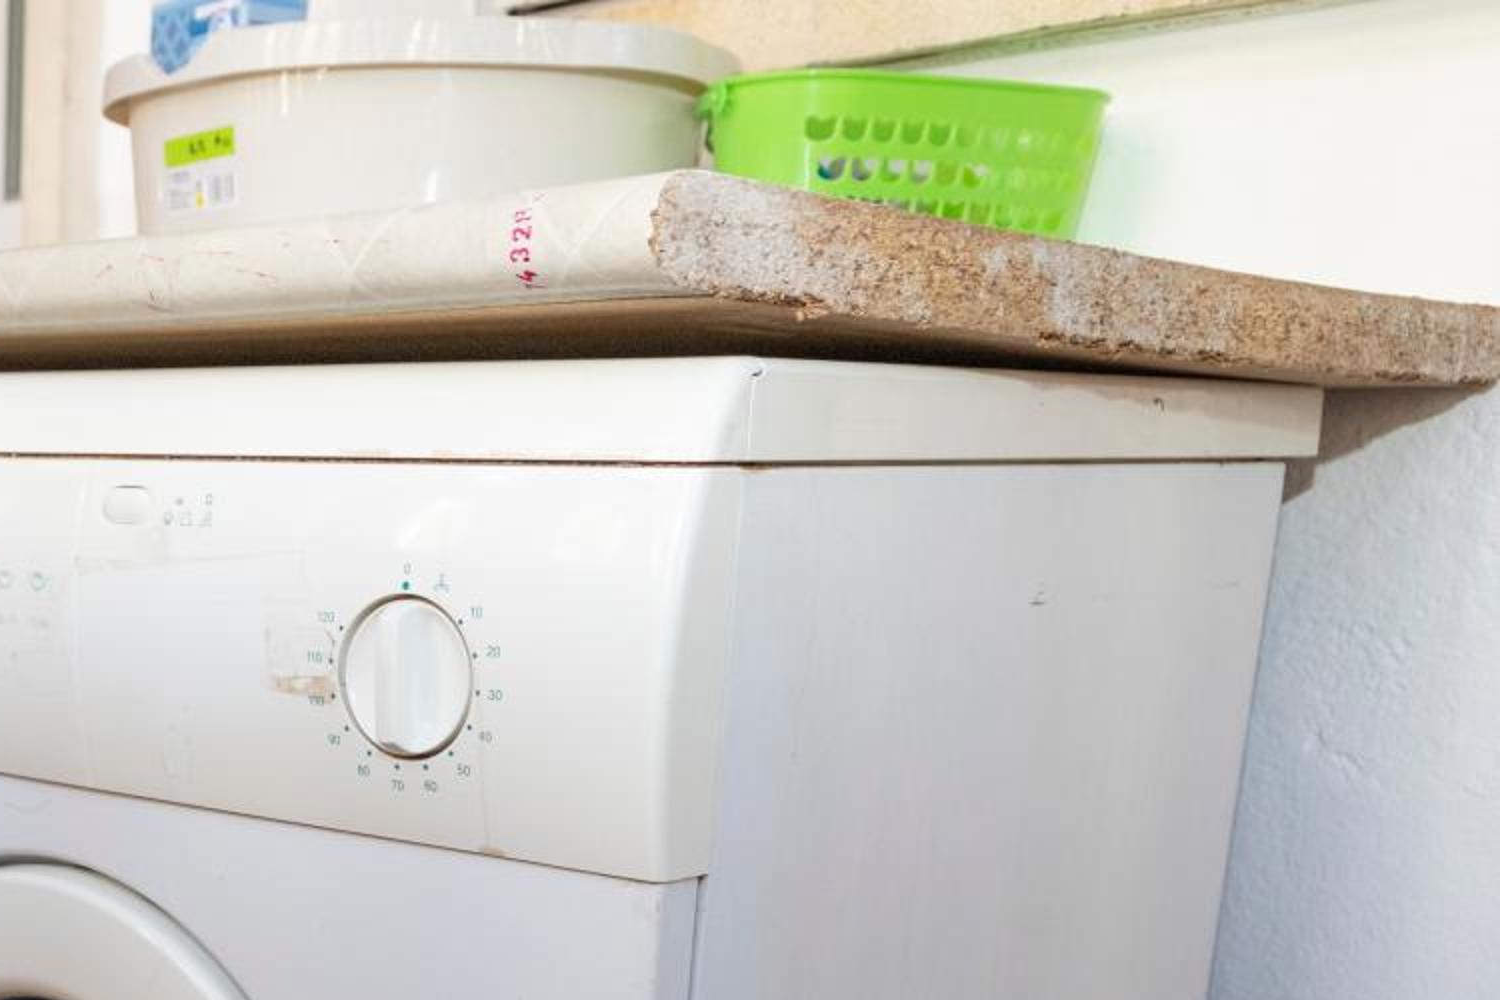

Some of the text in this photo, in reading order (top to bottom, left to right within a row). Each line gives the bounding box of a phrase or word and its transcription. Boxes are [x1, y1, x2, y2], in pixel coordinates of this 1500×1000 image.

[470, 607, 483, 618] 10
[485, 646, 501, 658] 20
[487, 690, 503, 701] 30
[327, 735, 341, 745] 90
[457, 765, 471, 776] 50
[391, 780, 404, 792] 70
